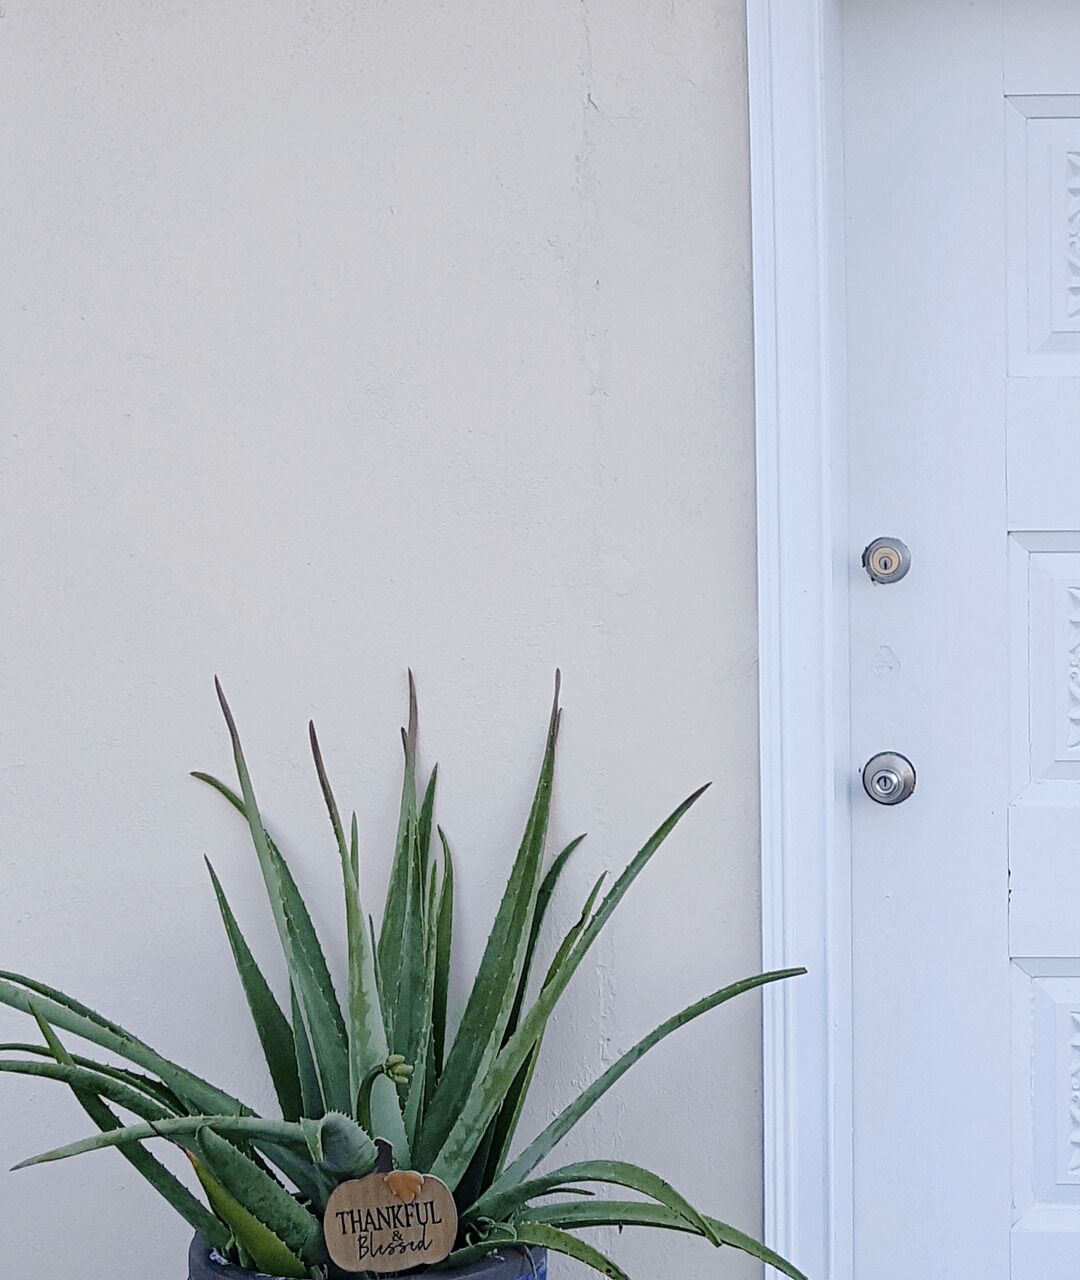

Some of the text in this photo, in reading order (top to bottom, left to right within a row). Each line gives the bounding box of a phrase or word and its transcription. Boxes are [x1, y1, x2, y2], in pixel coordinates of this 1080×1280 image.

[335, 1200, 443, 1234] THANKFUL
[358, 1224, 433, 1260] Blessed
[392, 1230, 403, 1242] &
